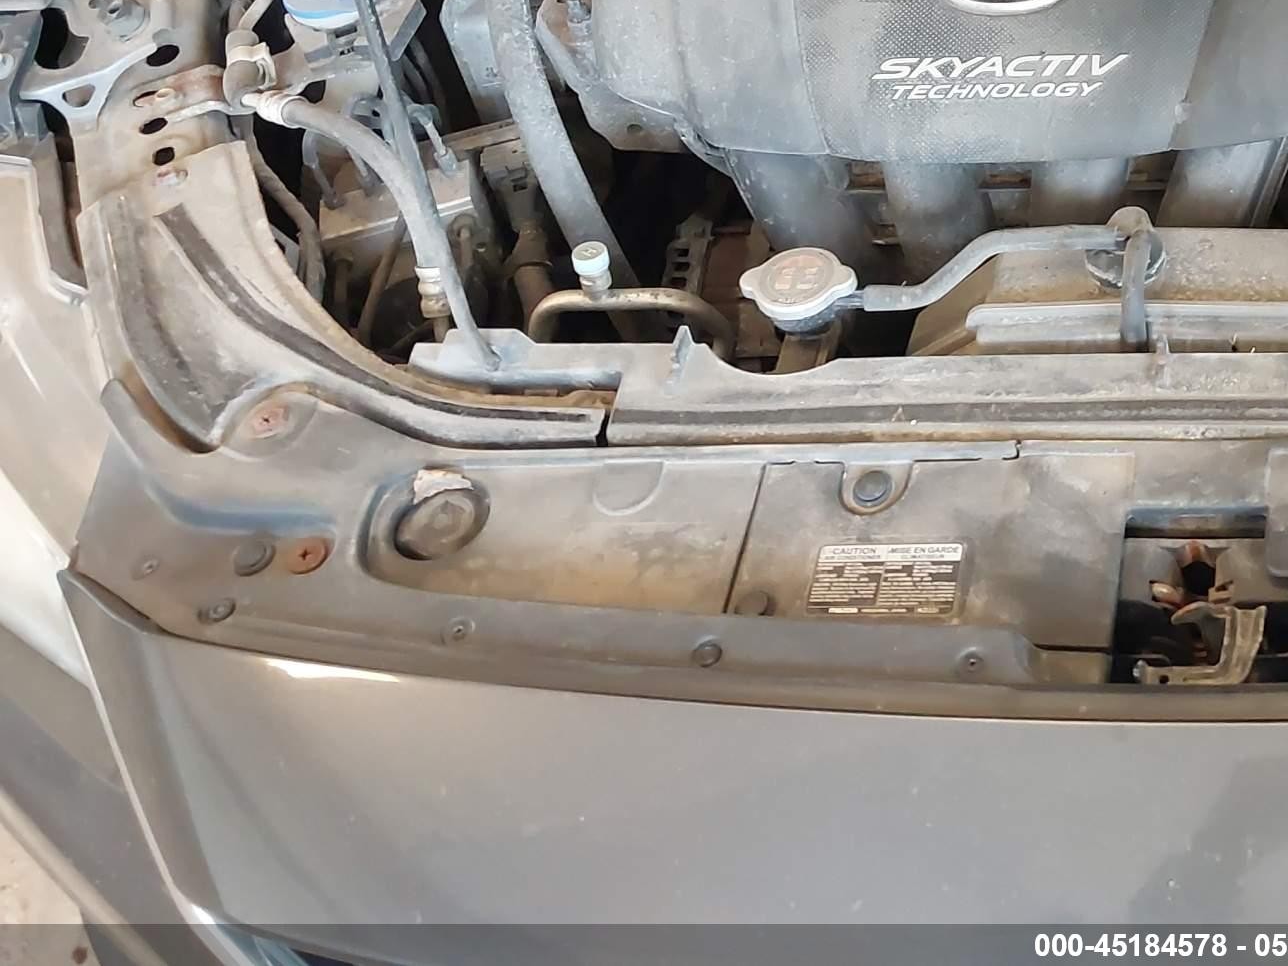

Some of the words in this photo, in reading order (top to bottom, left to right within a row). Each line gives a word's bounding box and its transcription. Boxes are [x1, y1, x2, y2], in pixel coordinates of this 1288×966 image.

[872, 54, 1129, 80] SKYACTIV
[891, 81, 1105, 100] TECHNOLOGY
[832, 547, 877, 555] CAUTION
[913, 546, 926, 554] EN
[927, 546, 959, 554] GARDE
